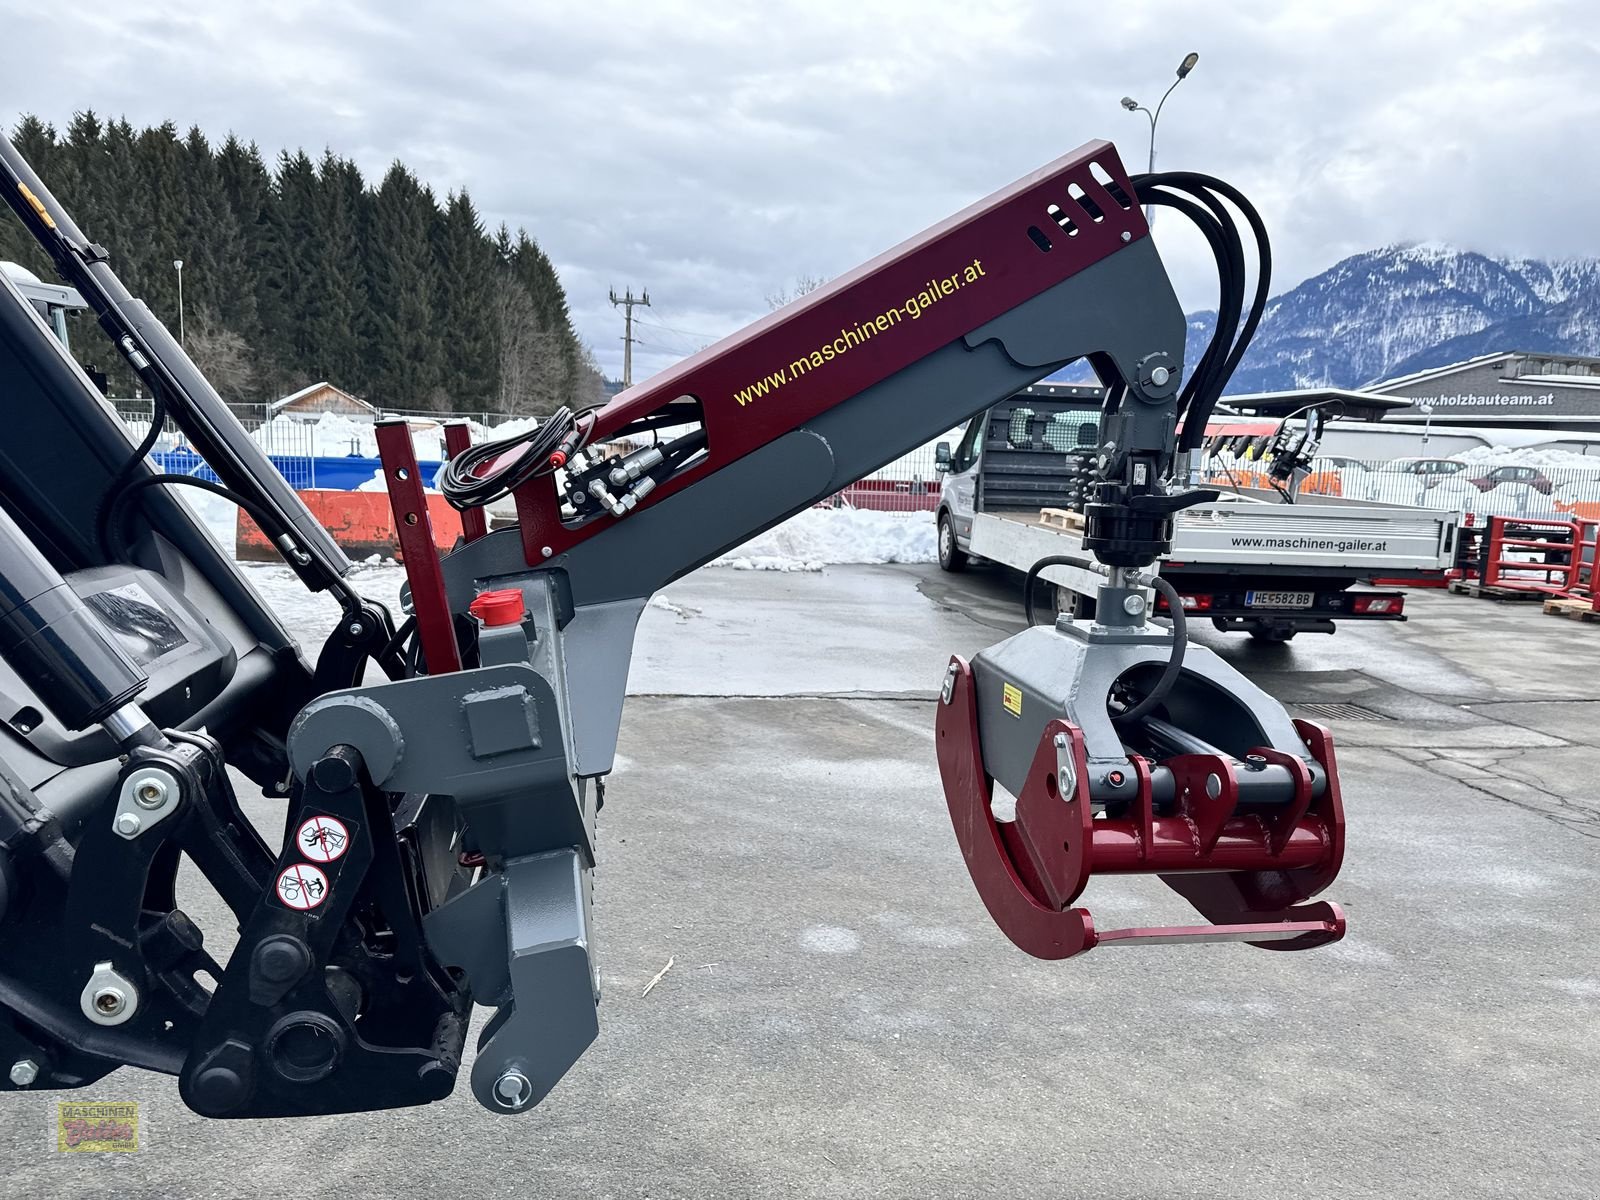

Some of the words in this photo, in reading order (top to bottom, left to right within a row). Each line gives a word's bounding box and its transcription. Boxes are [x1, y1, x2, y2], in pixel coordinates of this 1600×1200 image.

[734, 259, 986, 407] www.maschinen-gailer.at
[1231, 538, 1387, 552] www.maschinen-gailer.at
[1255, 593, 1268, 604] HE
[1275, 594, 1295, 604] 582
[1296, 594, 1310, 605] BB
